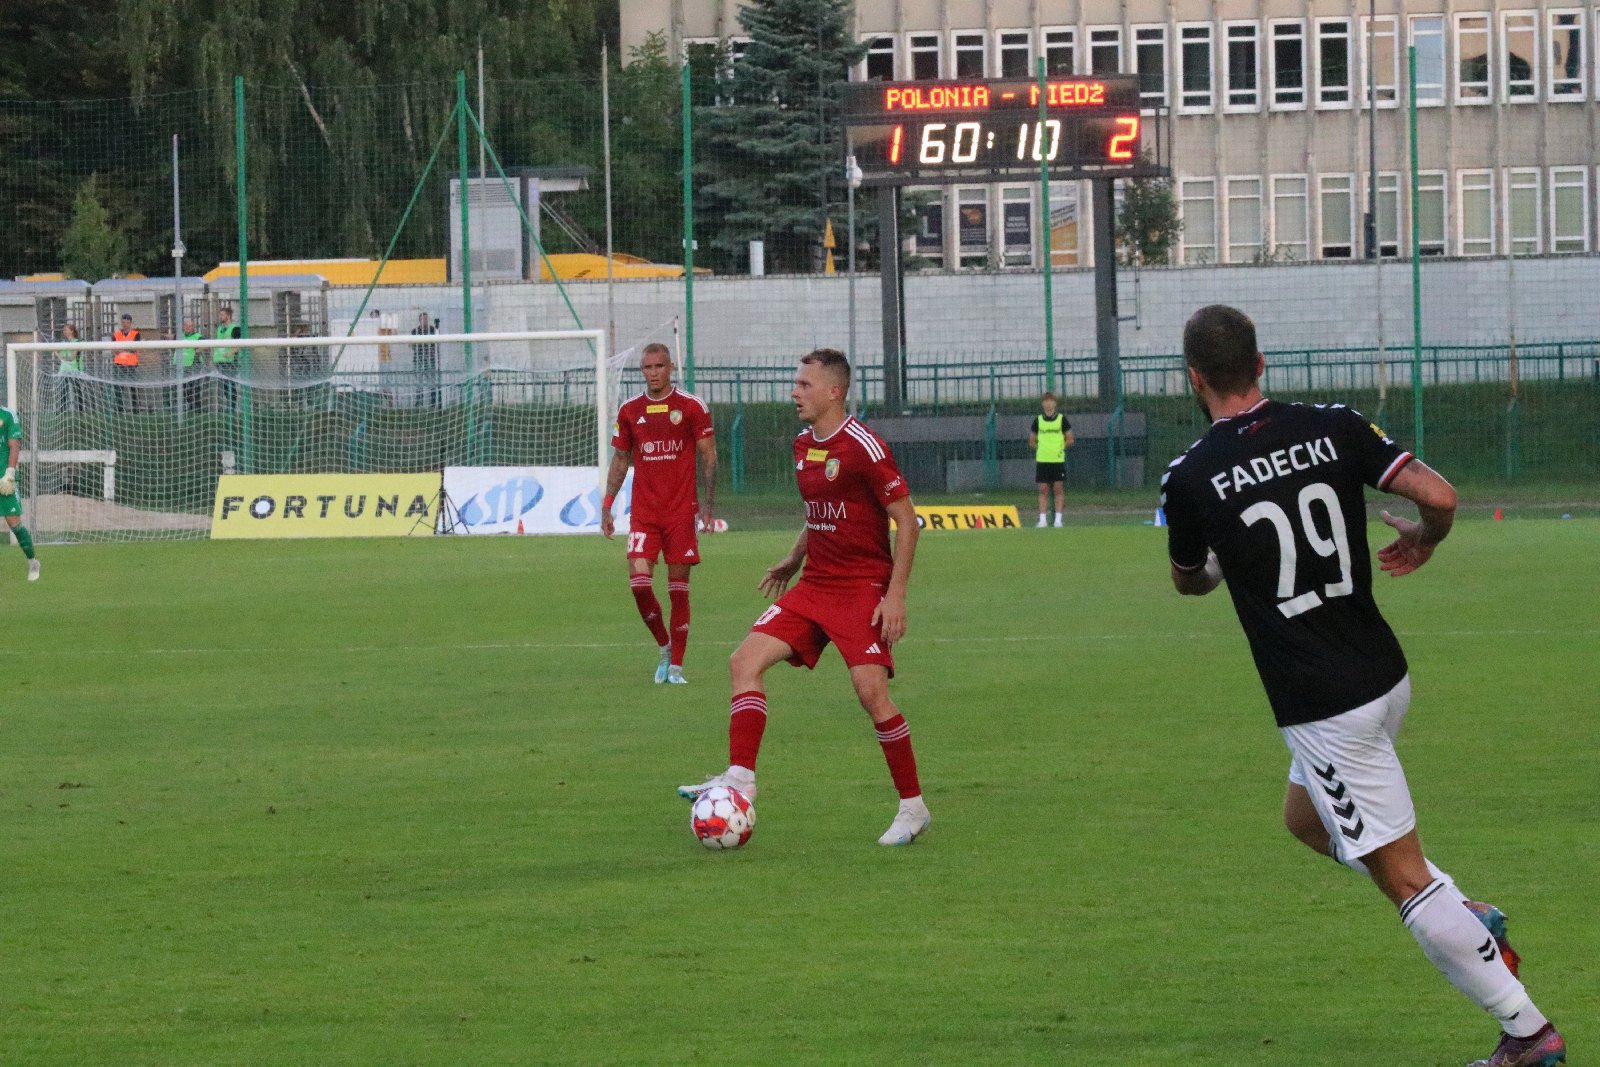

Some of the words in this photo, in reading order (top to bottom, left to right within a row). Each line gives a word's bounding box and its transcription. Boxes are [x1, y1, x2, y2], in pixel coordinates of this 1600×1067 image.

[886, 85, 989, 110] POLONIA
[890, 125, 902, 163] 1
[1109, 117, 1138, 159] 2
[1210, 436, 1339, 501] FADECKI
[221, 494, 430, 520] FORTUNA
[916, 513, 1017, 530] ORTUNA
[1240, 482, 1354, 619] 29
